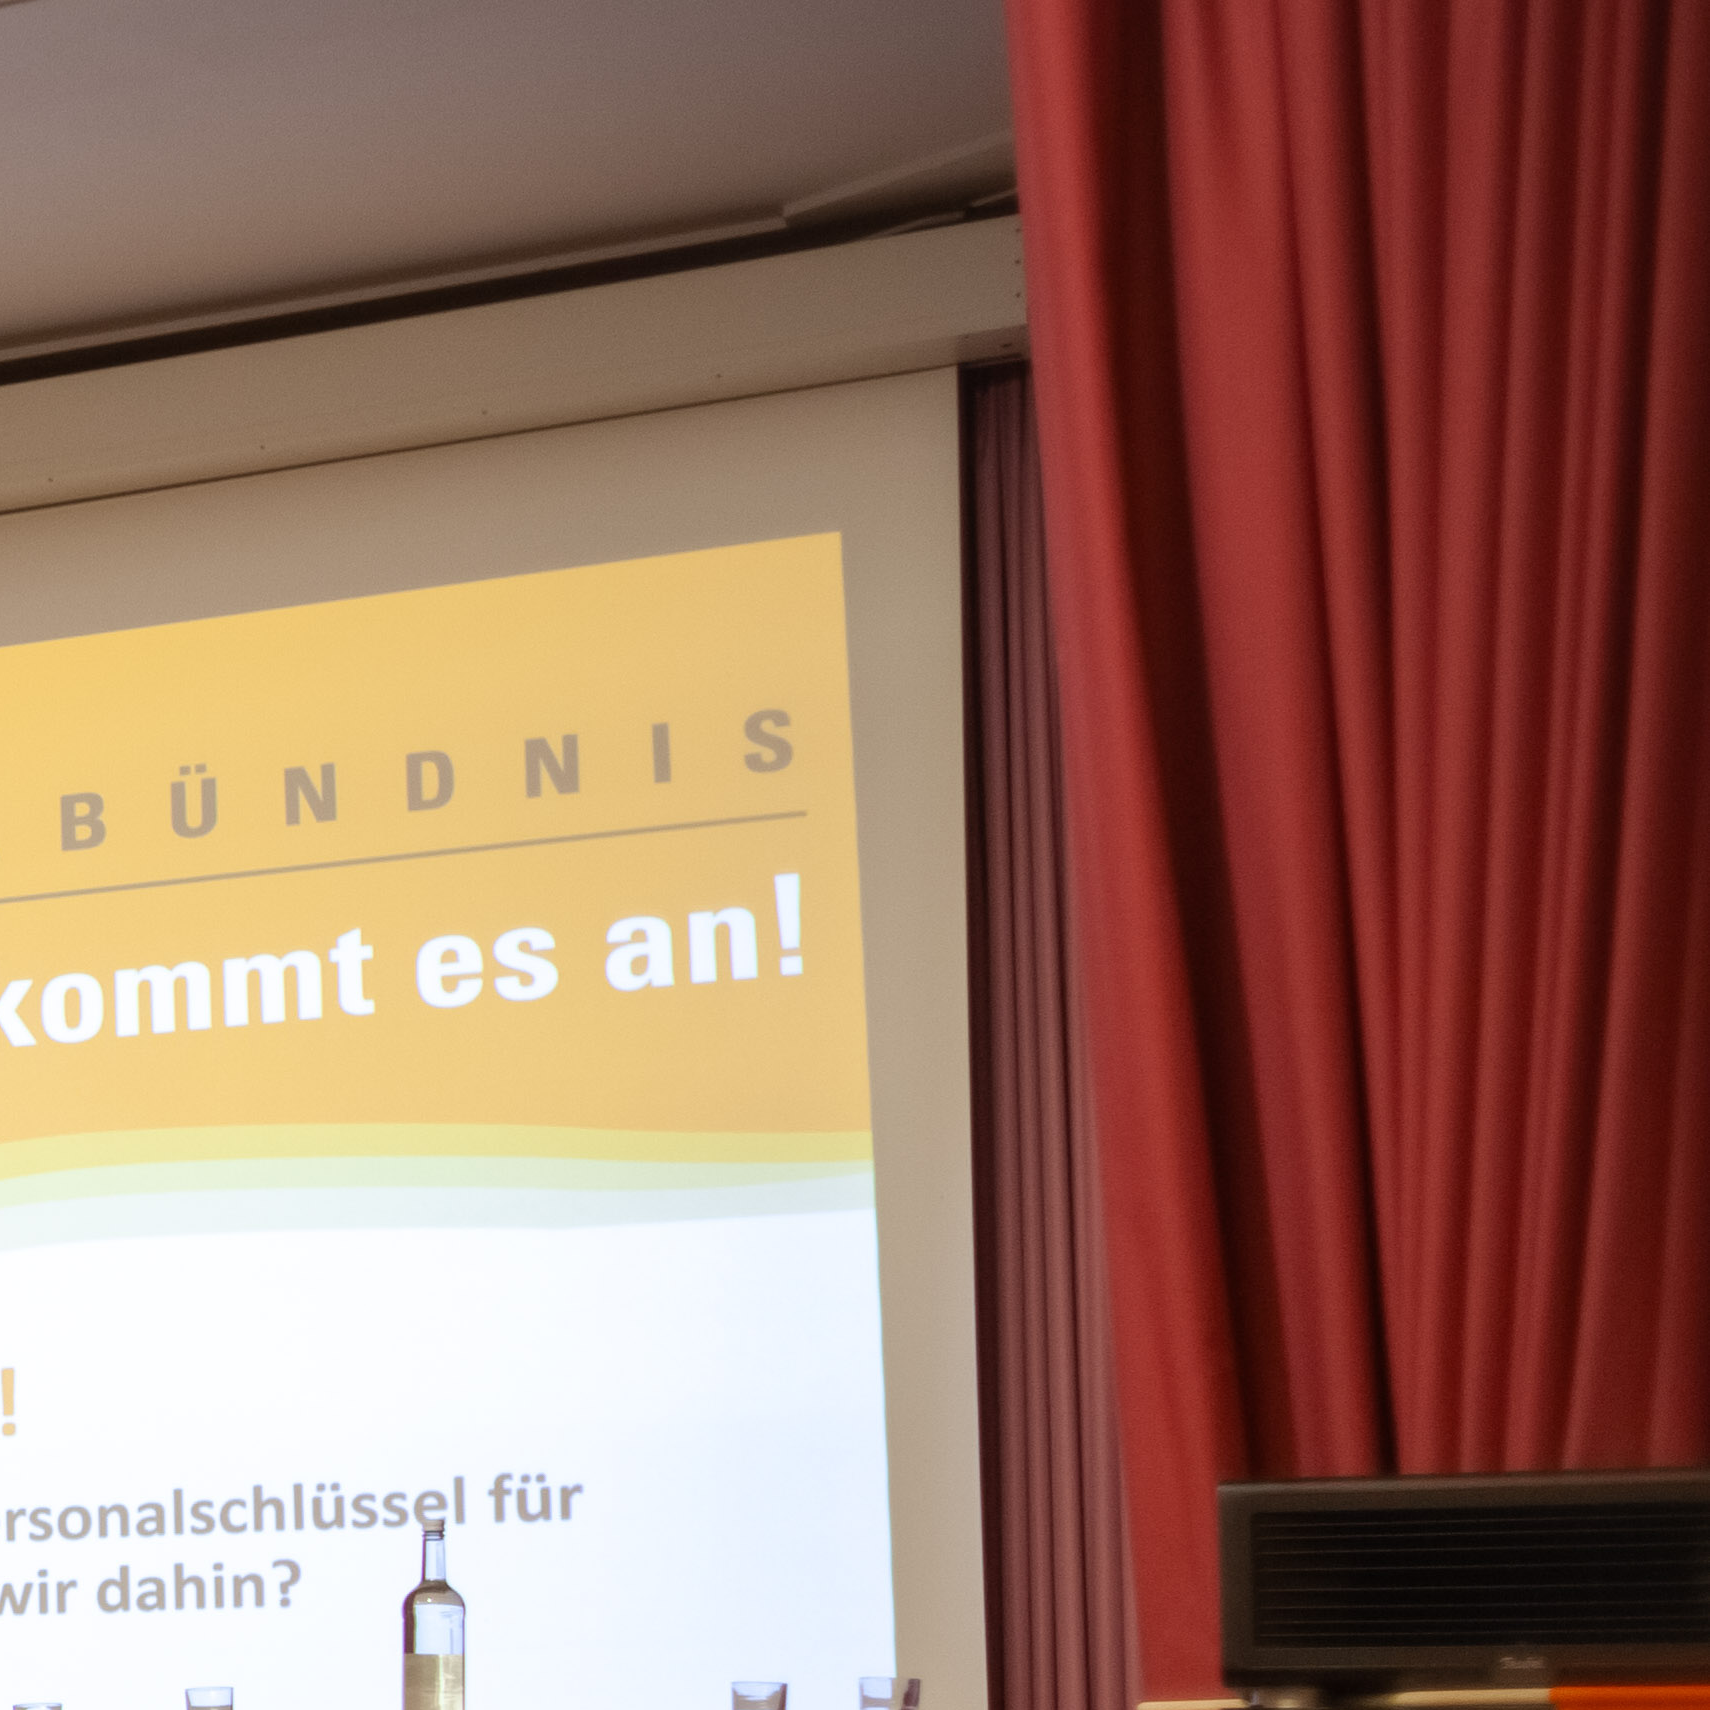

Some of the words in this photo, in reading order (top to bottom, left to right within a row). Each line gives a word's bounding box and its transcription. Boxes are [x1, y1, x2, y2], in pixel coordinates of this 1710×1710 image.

[416, 926, 560, 1008] es
[605, 872, 804, 992] an!
[489, 1472, 584, 1524] für
[97, 1559, 302, 1614] dahin?
